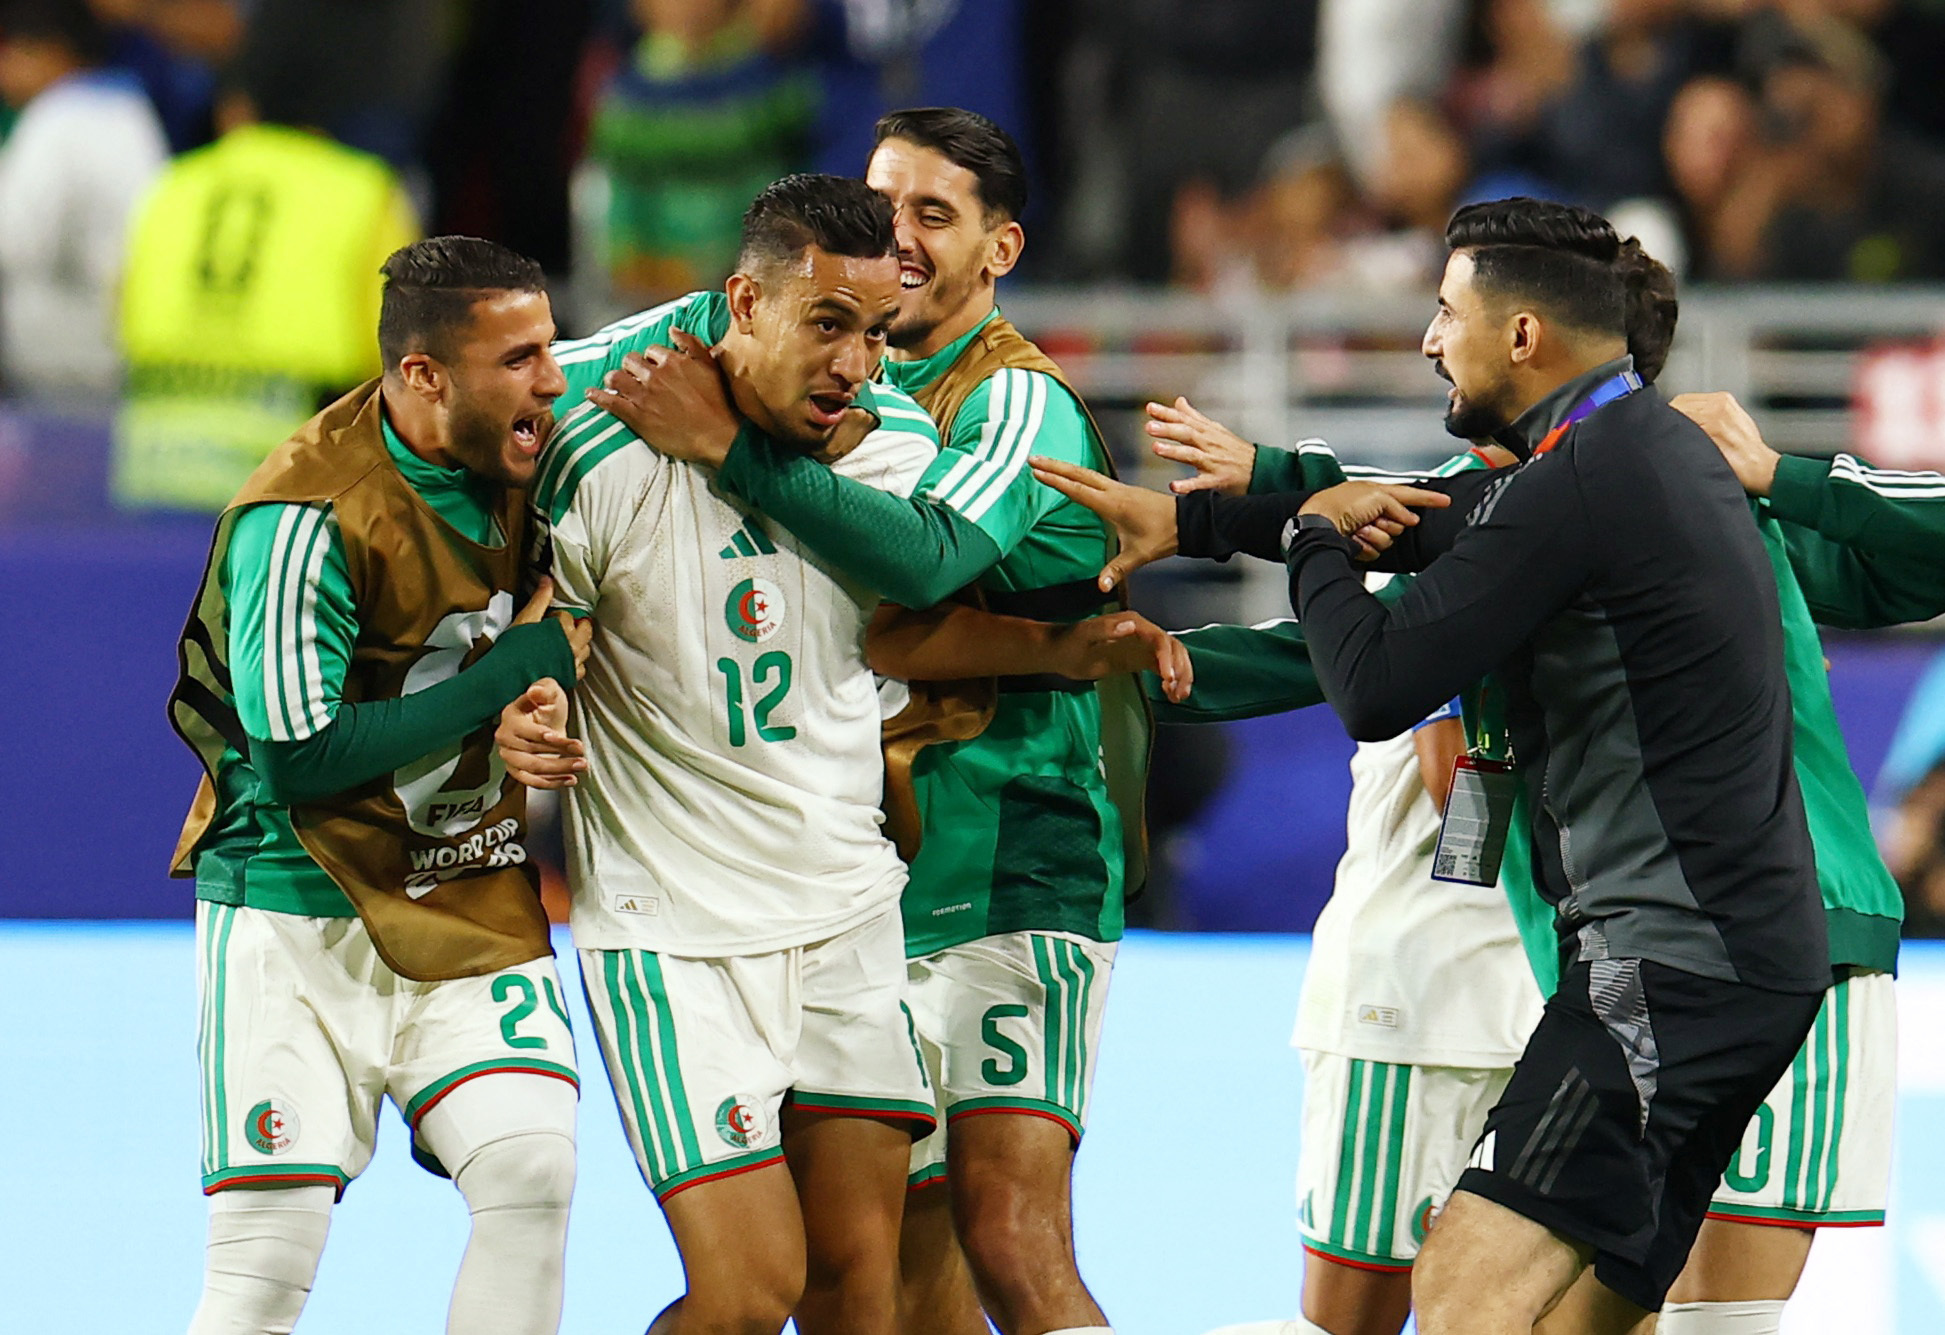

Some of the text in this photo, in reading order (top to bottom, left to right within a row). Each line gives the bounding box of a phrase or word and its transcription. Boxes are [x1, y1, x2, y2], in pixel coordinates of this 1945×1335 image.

[737, 621, 777, 637] ALGERIA
[717, 650, 797, 747] 12
[426, 795, 484, 828] FIFA
[410, 834, 484, 871] WORD
